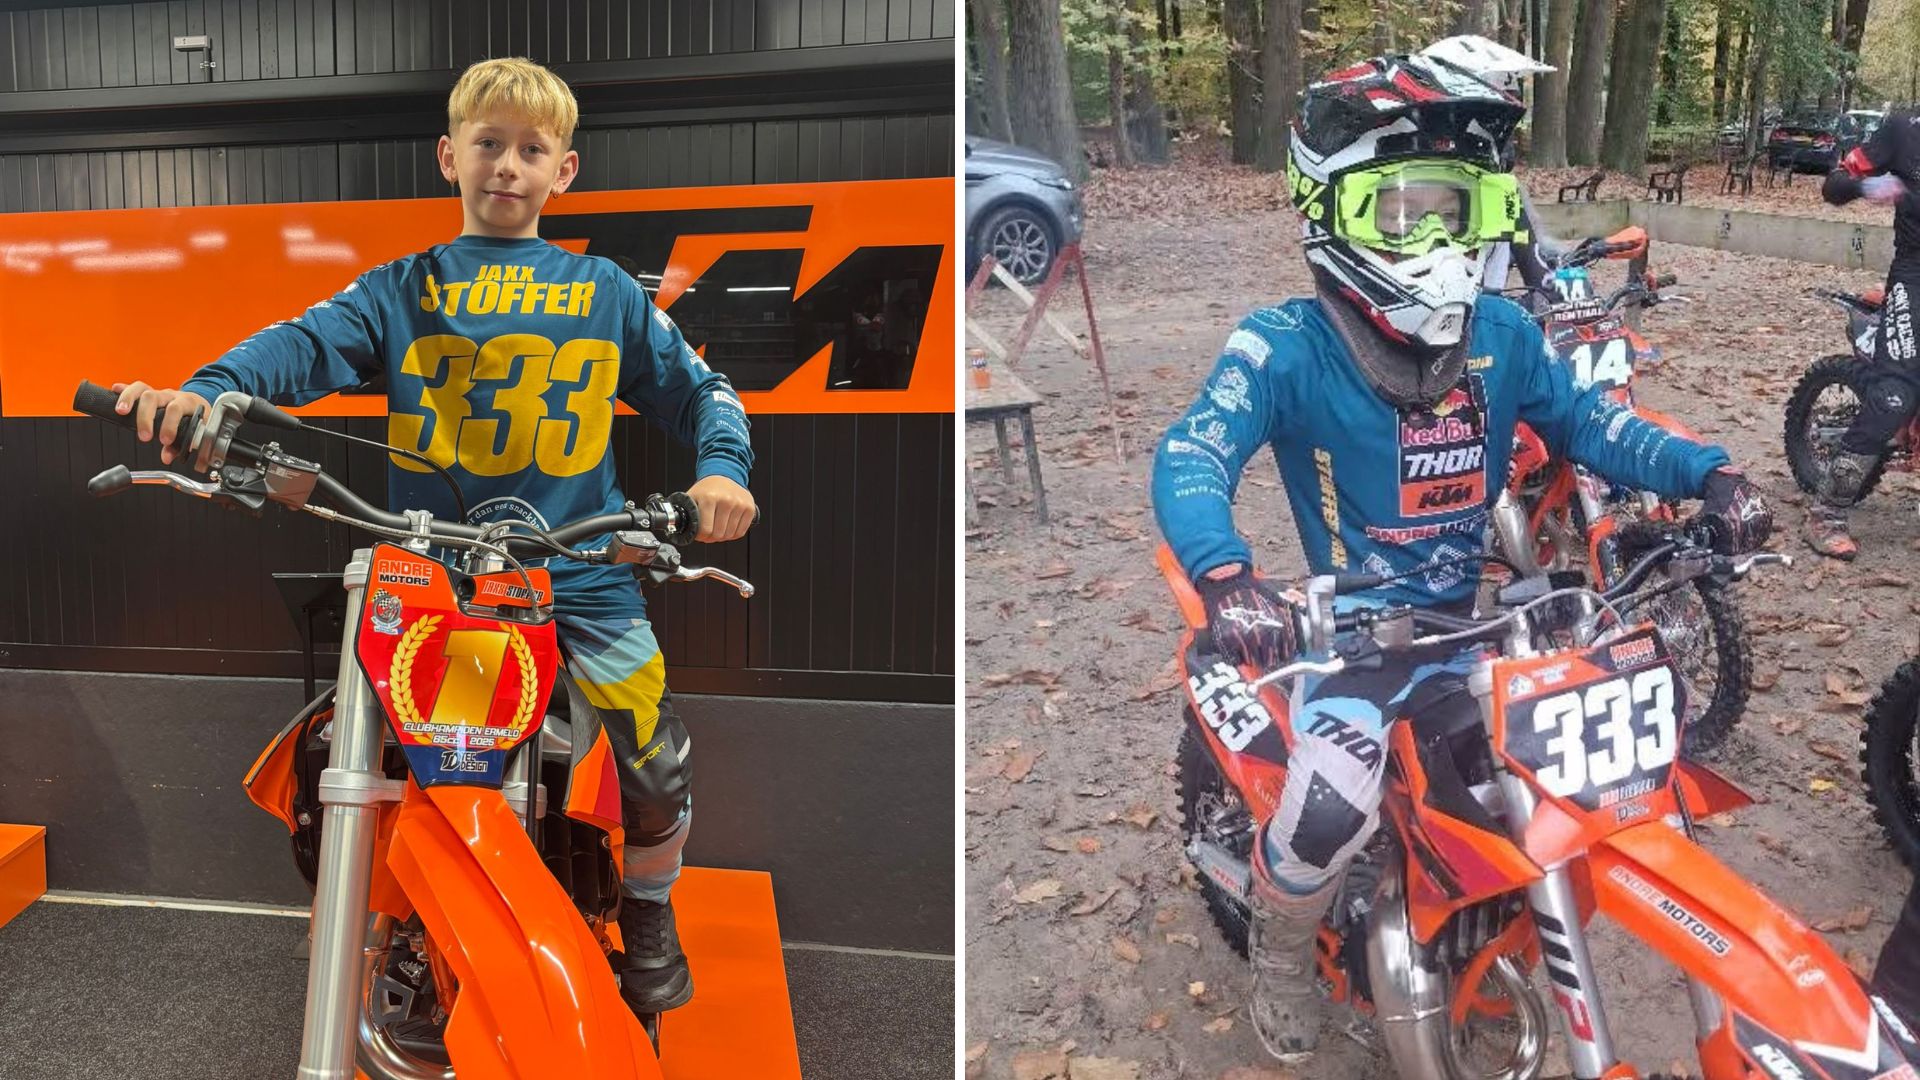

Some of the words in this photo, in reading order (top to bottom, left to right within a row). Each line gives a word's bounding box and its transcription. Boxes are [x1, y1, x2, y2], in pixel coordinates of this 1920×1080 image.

[475, 264, 536, 282] JAXX
[420, 274, 597, 317] STOFFER
[1570, 339, 1634, 392] 14
[387, 334, 621, 478] 333
[1446, 411, 1484, 443] Bul
[1405, 445, 1484, 479] THOR
[1416, 482, 1474, 509] KTM
[475, 506, 493, 519] dan
[379, 560, 432, 578] ANDRE
[379, 574, 430, 586] MOTORS
[506, 585, 544, 602] STOFFR
[428, 630, 511, 729] 1
[1188, 662, 1271, 752] 333
[469, 736, 495, 746] 2025
[1532, 666, 1676, 798] 333
[633, 741, 665, 769] SPORT
[1658, 899, 1729, 954] MOTORS
[1752, 1043, 1804, 1080] KT
